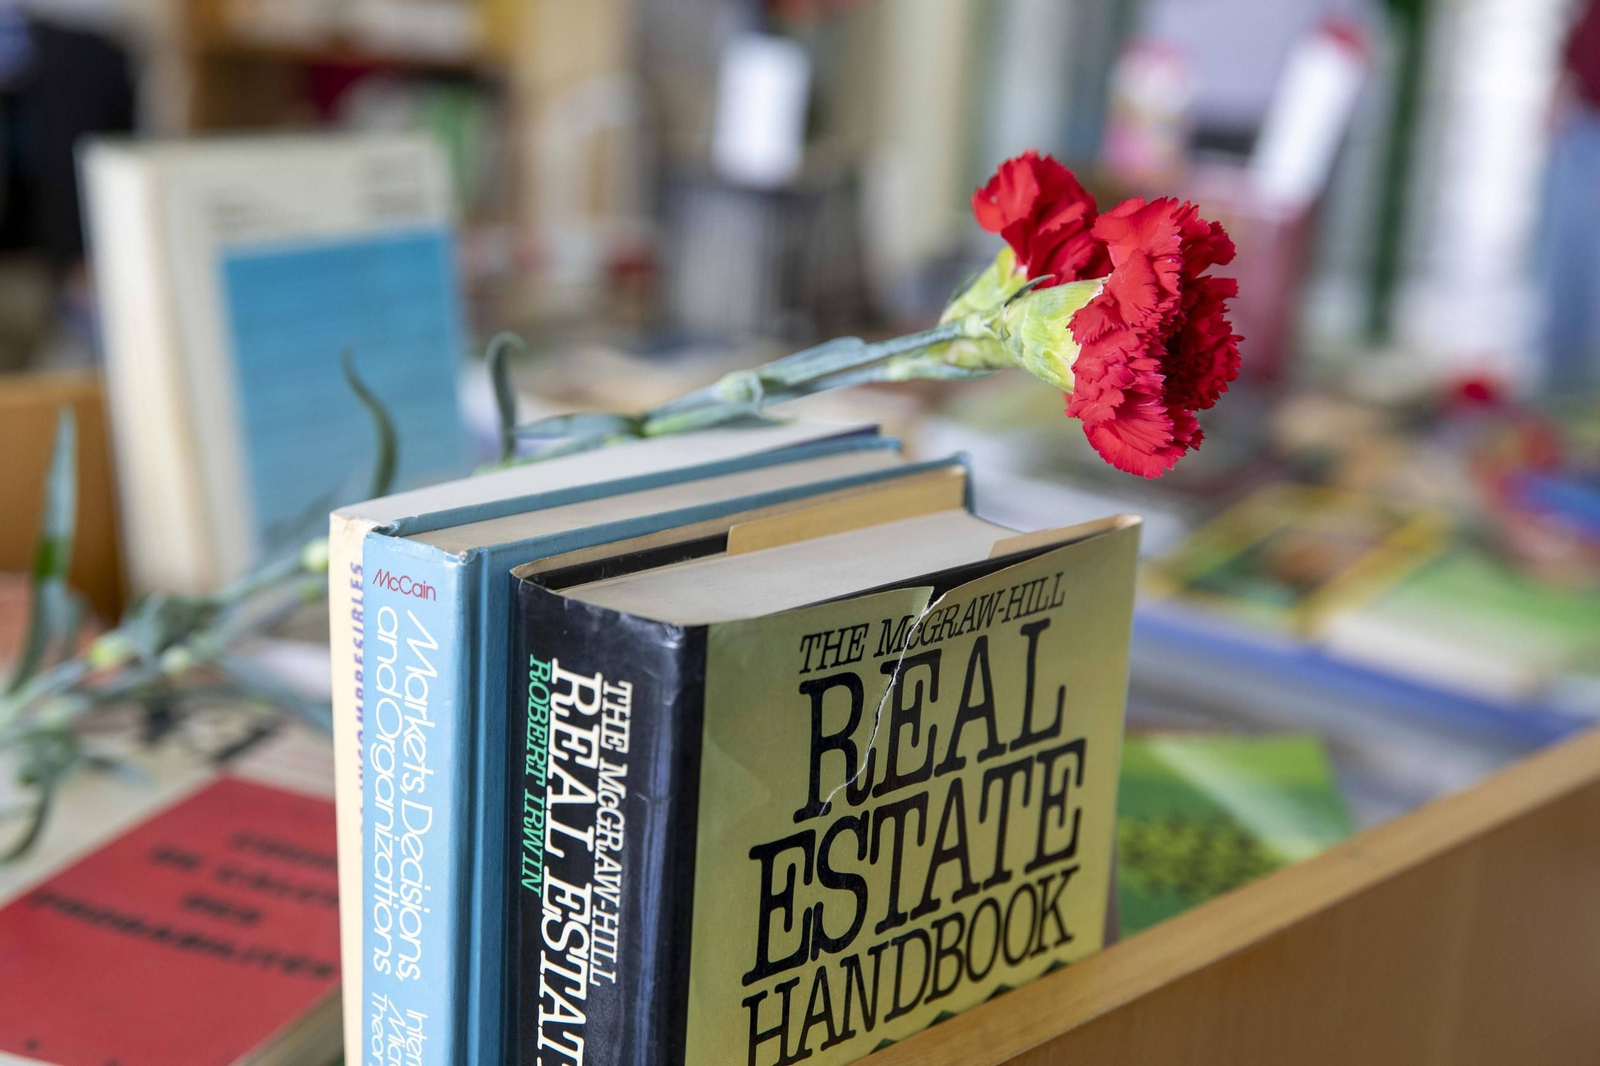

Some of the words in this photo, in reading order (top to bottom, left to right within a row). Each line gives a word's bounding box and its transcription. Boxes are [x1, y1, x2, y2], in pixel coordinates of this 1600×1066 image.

[372, 568, 437, 602] McCain
[376, 605, 403, 699] and
[799, 622, 870, 675] THE
[873, 571, 1066, 659] McGRAW-HILL
[399, 609, 439, 796] Markets,
[525, 653, 552, 788] ROBERT
[544, 657, 604, 859] REAL
[600, 679, 634, 754] THE
[792, 617, 1067, 824] REAL
[369, 697, 403, 976] Organizations
[394, 797, 434, 982] Decisions,
[520, 788, 546, 898] IRWIN
[588, 757, 629, 987] McGRAW-HILL
[741, 737, 1087, 987] ESTATE
[368, 991, 388, 1066] Theor
[387, 999, 406, 1066] Micr
[536, 865, 593, 1066] ESTAT
[741, 864, 1080, 1066] HANDBOOK
